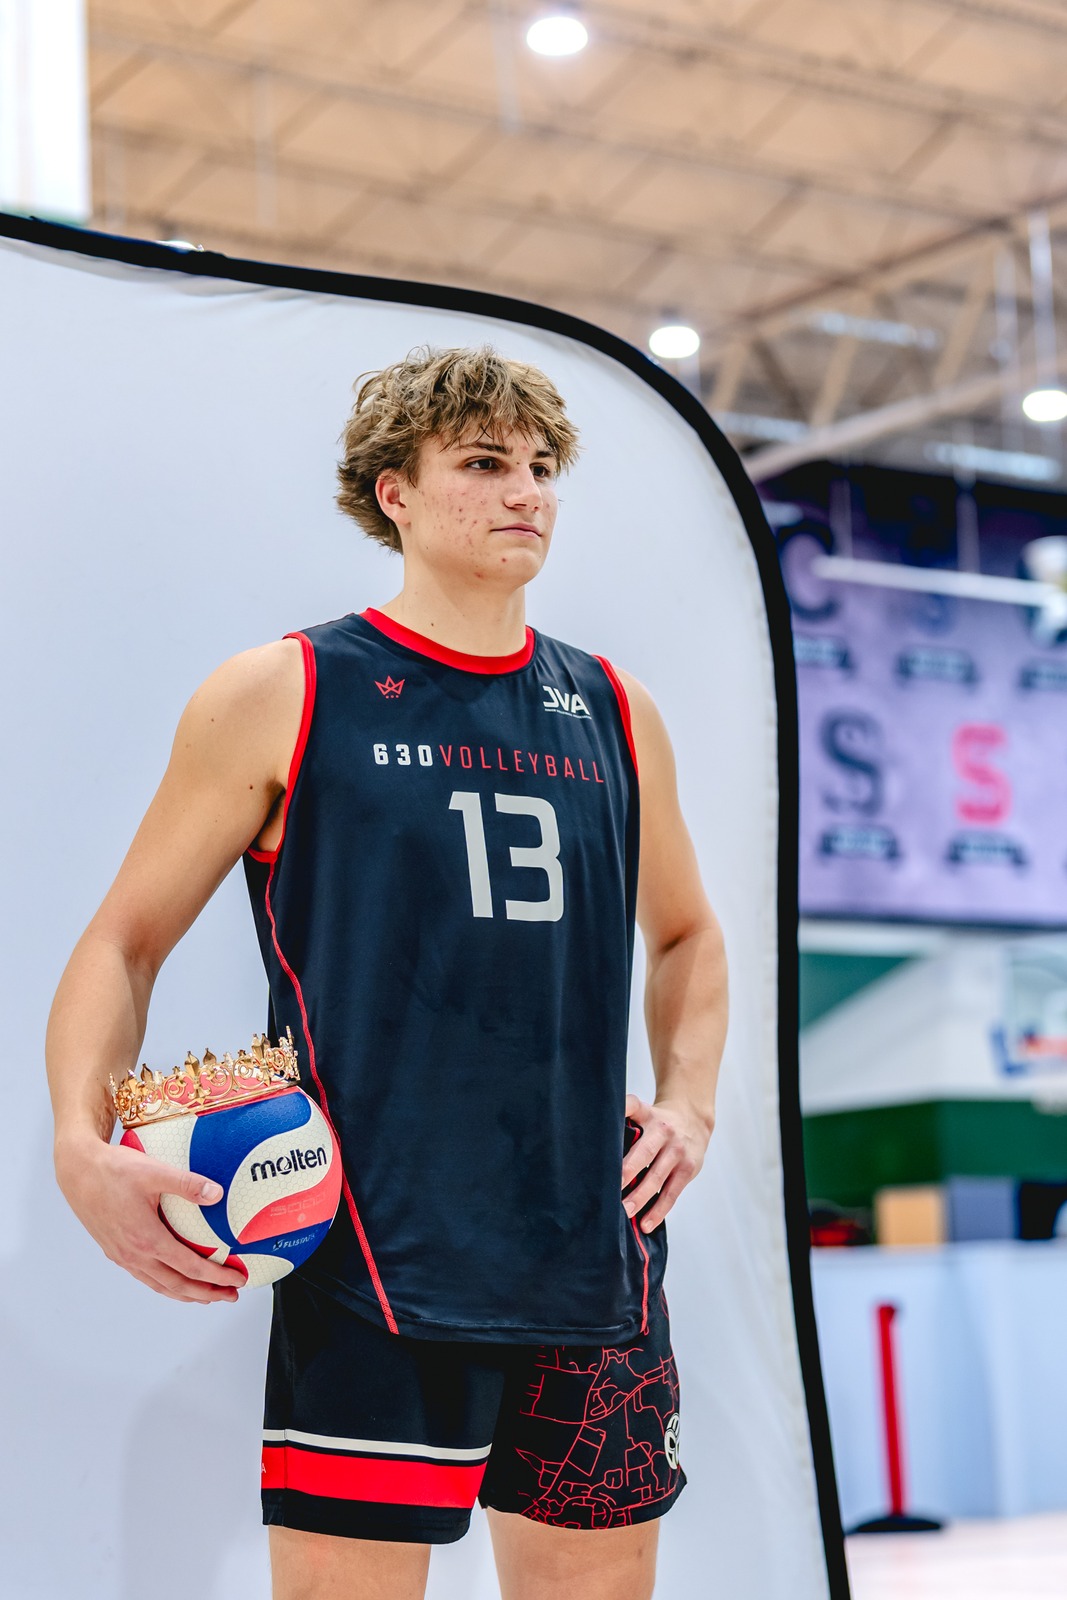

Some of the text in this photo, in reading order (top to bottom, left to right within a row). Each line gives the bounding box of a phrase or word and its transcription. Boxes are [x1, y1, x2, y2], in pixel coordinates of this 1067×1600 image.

[542, 685, 591, 716] JVA
[439, 744, 605, 783] VOLLEYBALL
[951, 722, 1013, 828] S
[448, 791, 565, 922] 13
[250, 1147, 327, 1182] molten
